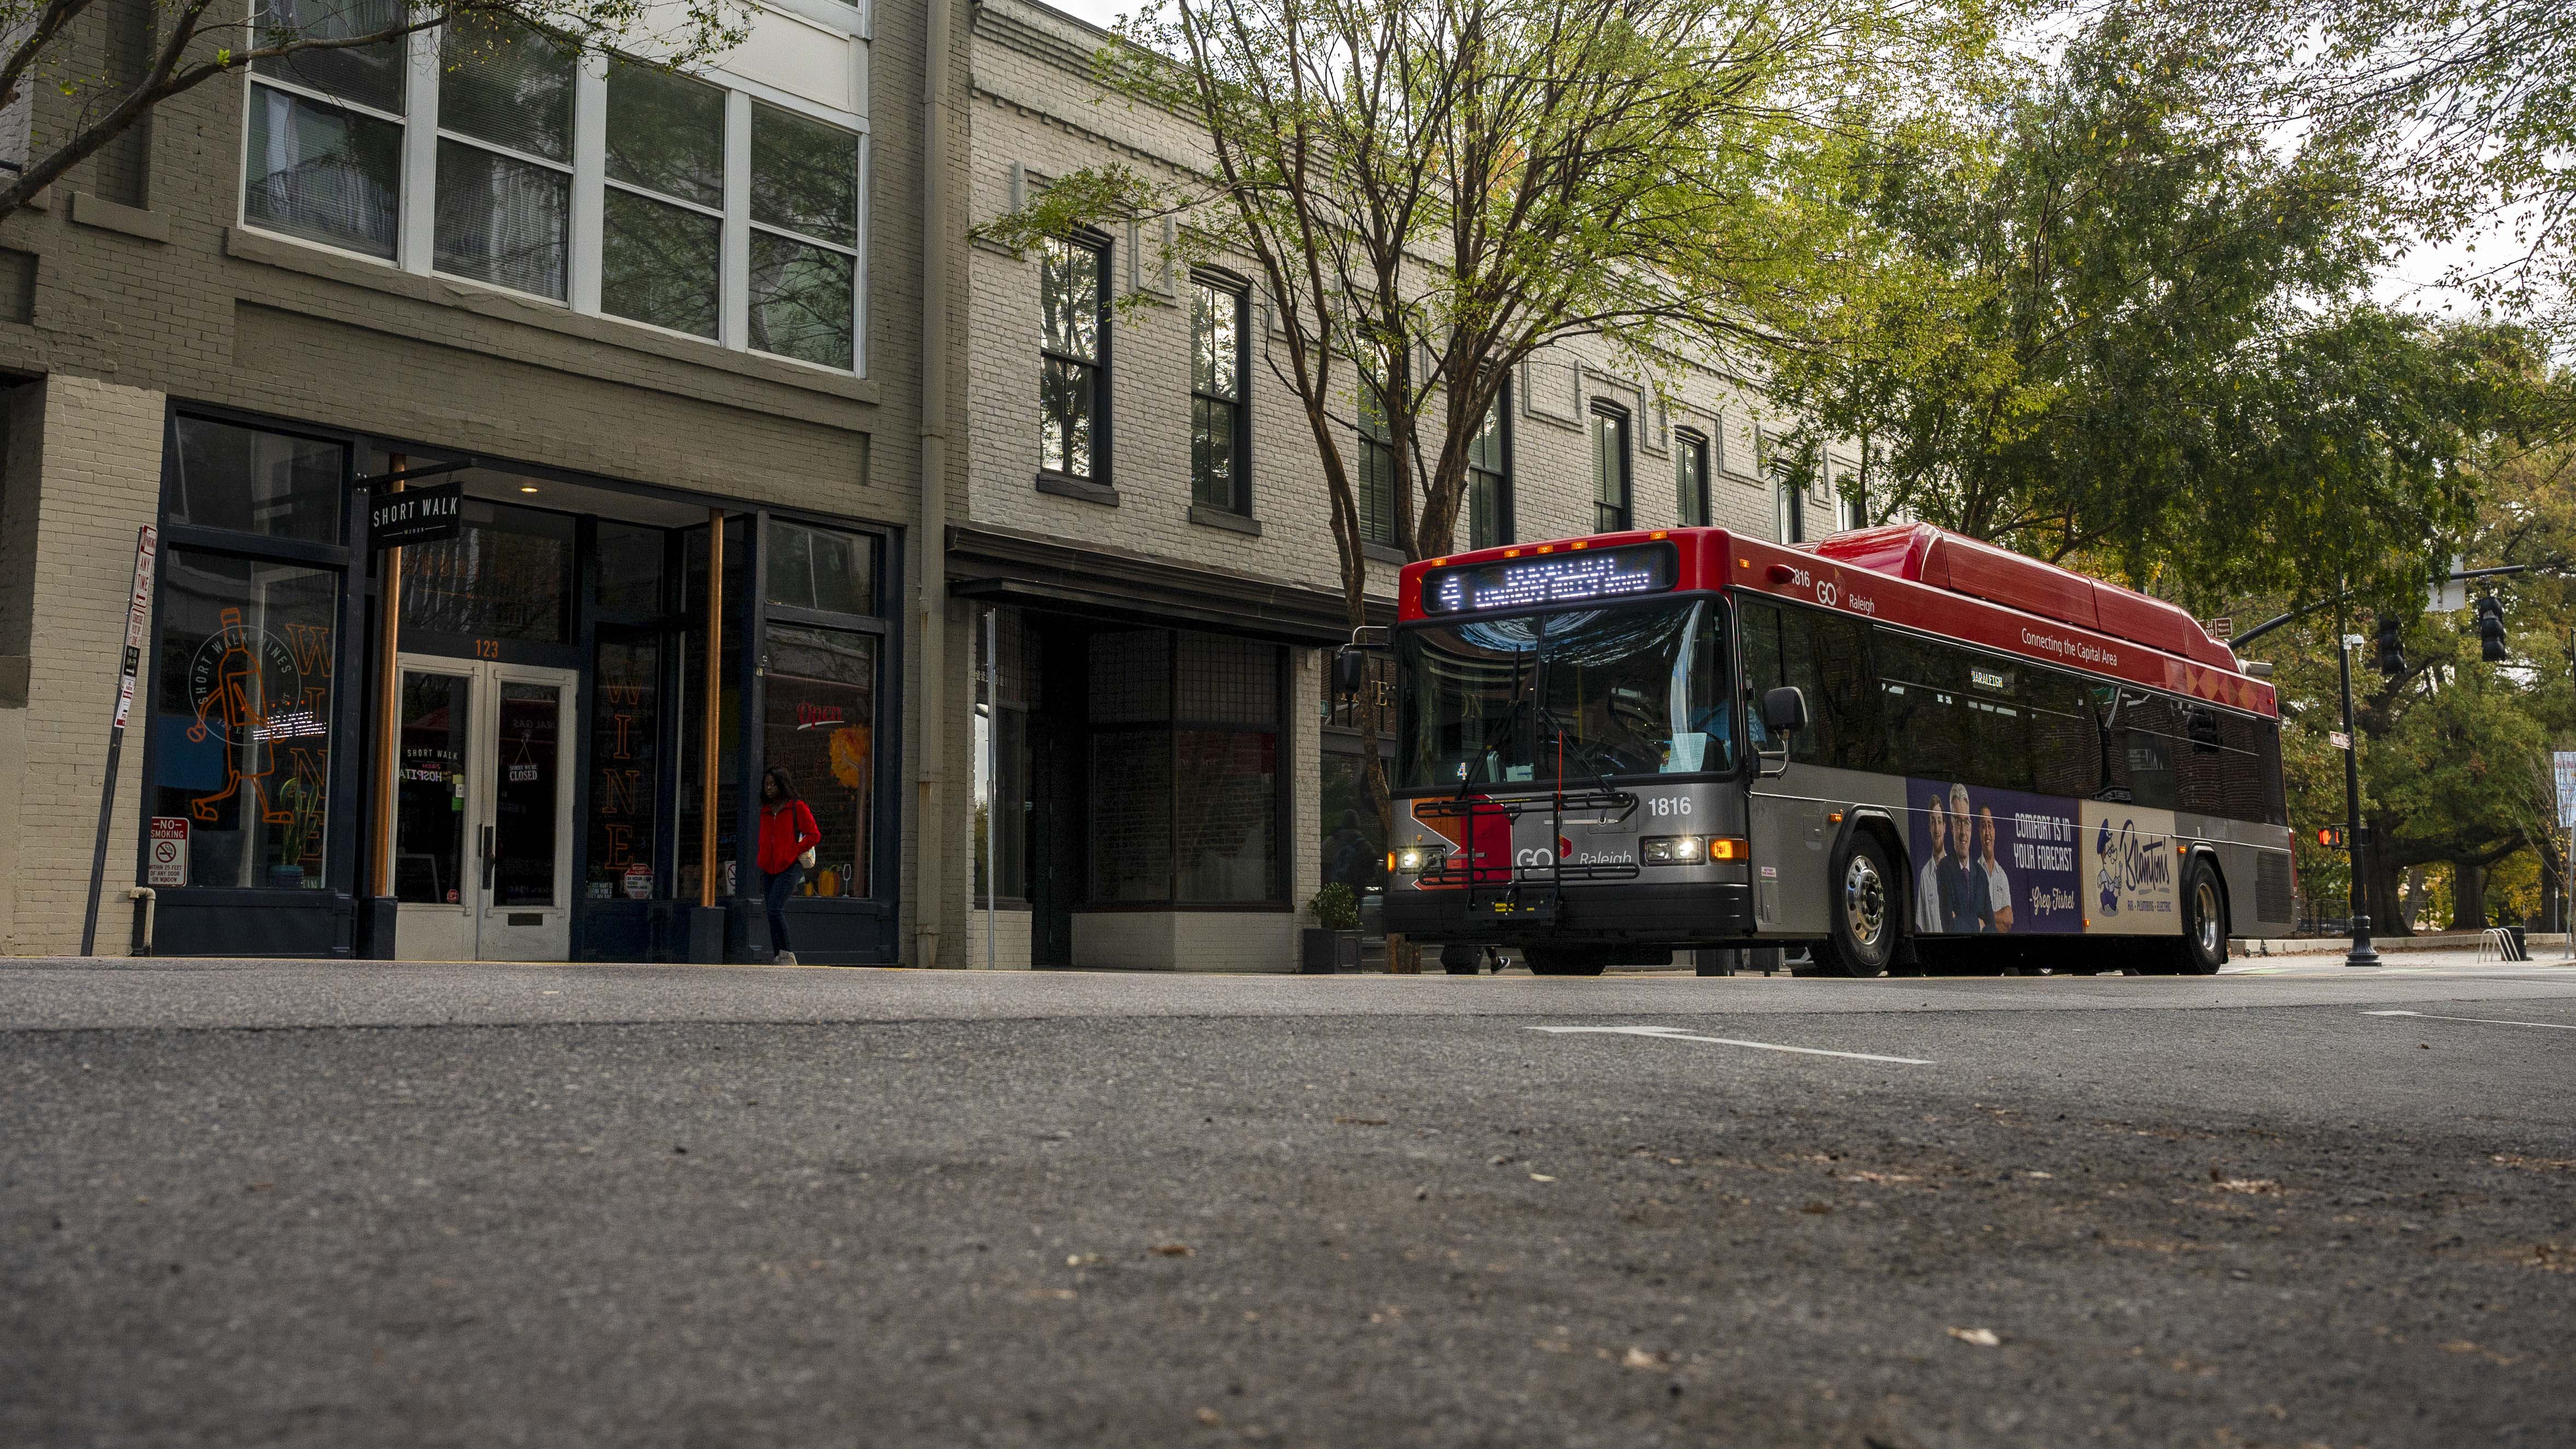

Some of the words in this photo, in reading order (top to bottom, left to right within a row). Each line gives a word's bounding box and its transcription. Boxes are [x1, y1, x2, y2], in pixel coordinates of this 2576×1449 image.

[374, 501, 414, 528] SHORT
[423, 497, 458, 516] WALK
[140, 556, 150, 572] ANY
[137, 573, 149, 592] TIME
[1442, 576, 1461, 611] 4
[1817, 581, 1836, 606] GO
[1849, 594, 1875, 615] Raleigh
[476, 638, 499, 659] 123
[2022, 628, 2062, 657] Connecting
[2064, 638, 2075, 656] the
[2078, 642, 2100, 663] Capital
[2102, 649, 2117, 666] Area
[195, 657, 212, 705] SHORT
[797, 701, 842, 730] Open
[407, 749, 433, 757] SHORT
[437, 750, 457, 760] WALK
[509, 770, 537, 781] CLOSED
[1457, 762, 1467, 780] 4
[1648, 796, 1692, 816] 1816
[150, 830, 184, 838] SMOKING
[2015, 813, 2051, 840] COMFORT
[2053, 817, 2061, 841] IS
[2063, 818, 2071, 842] IN
[1517, 848, 1553, 871] GO
[1580, 850, 1632, 868] Raleigh
[2014, 843, 2035, 870] YOUR
[2037, 845, 2072, 871] FORECAST
[2120, 819, 2169, 891] Blanton's
[2052, 887, 2074, 911] Fishel
[2137, 900, 2154, 912] PLUMBING
[2157, 901, 2171, 912] ELECTRIC
